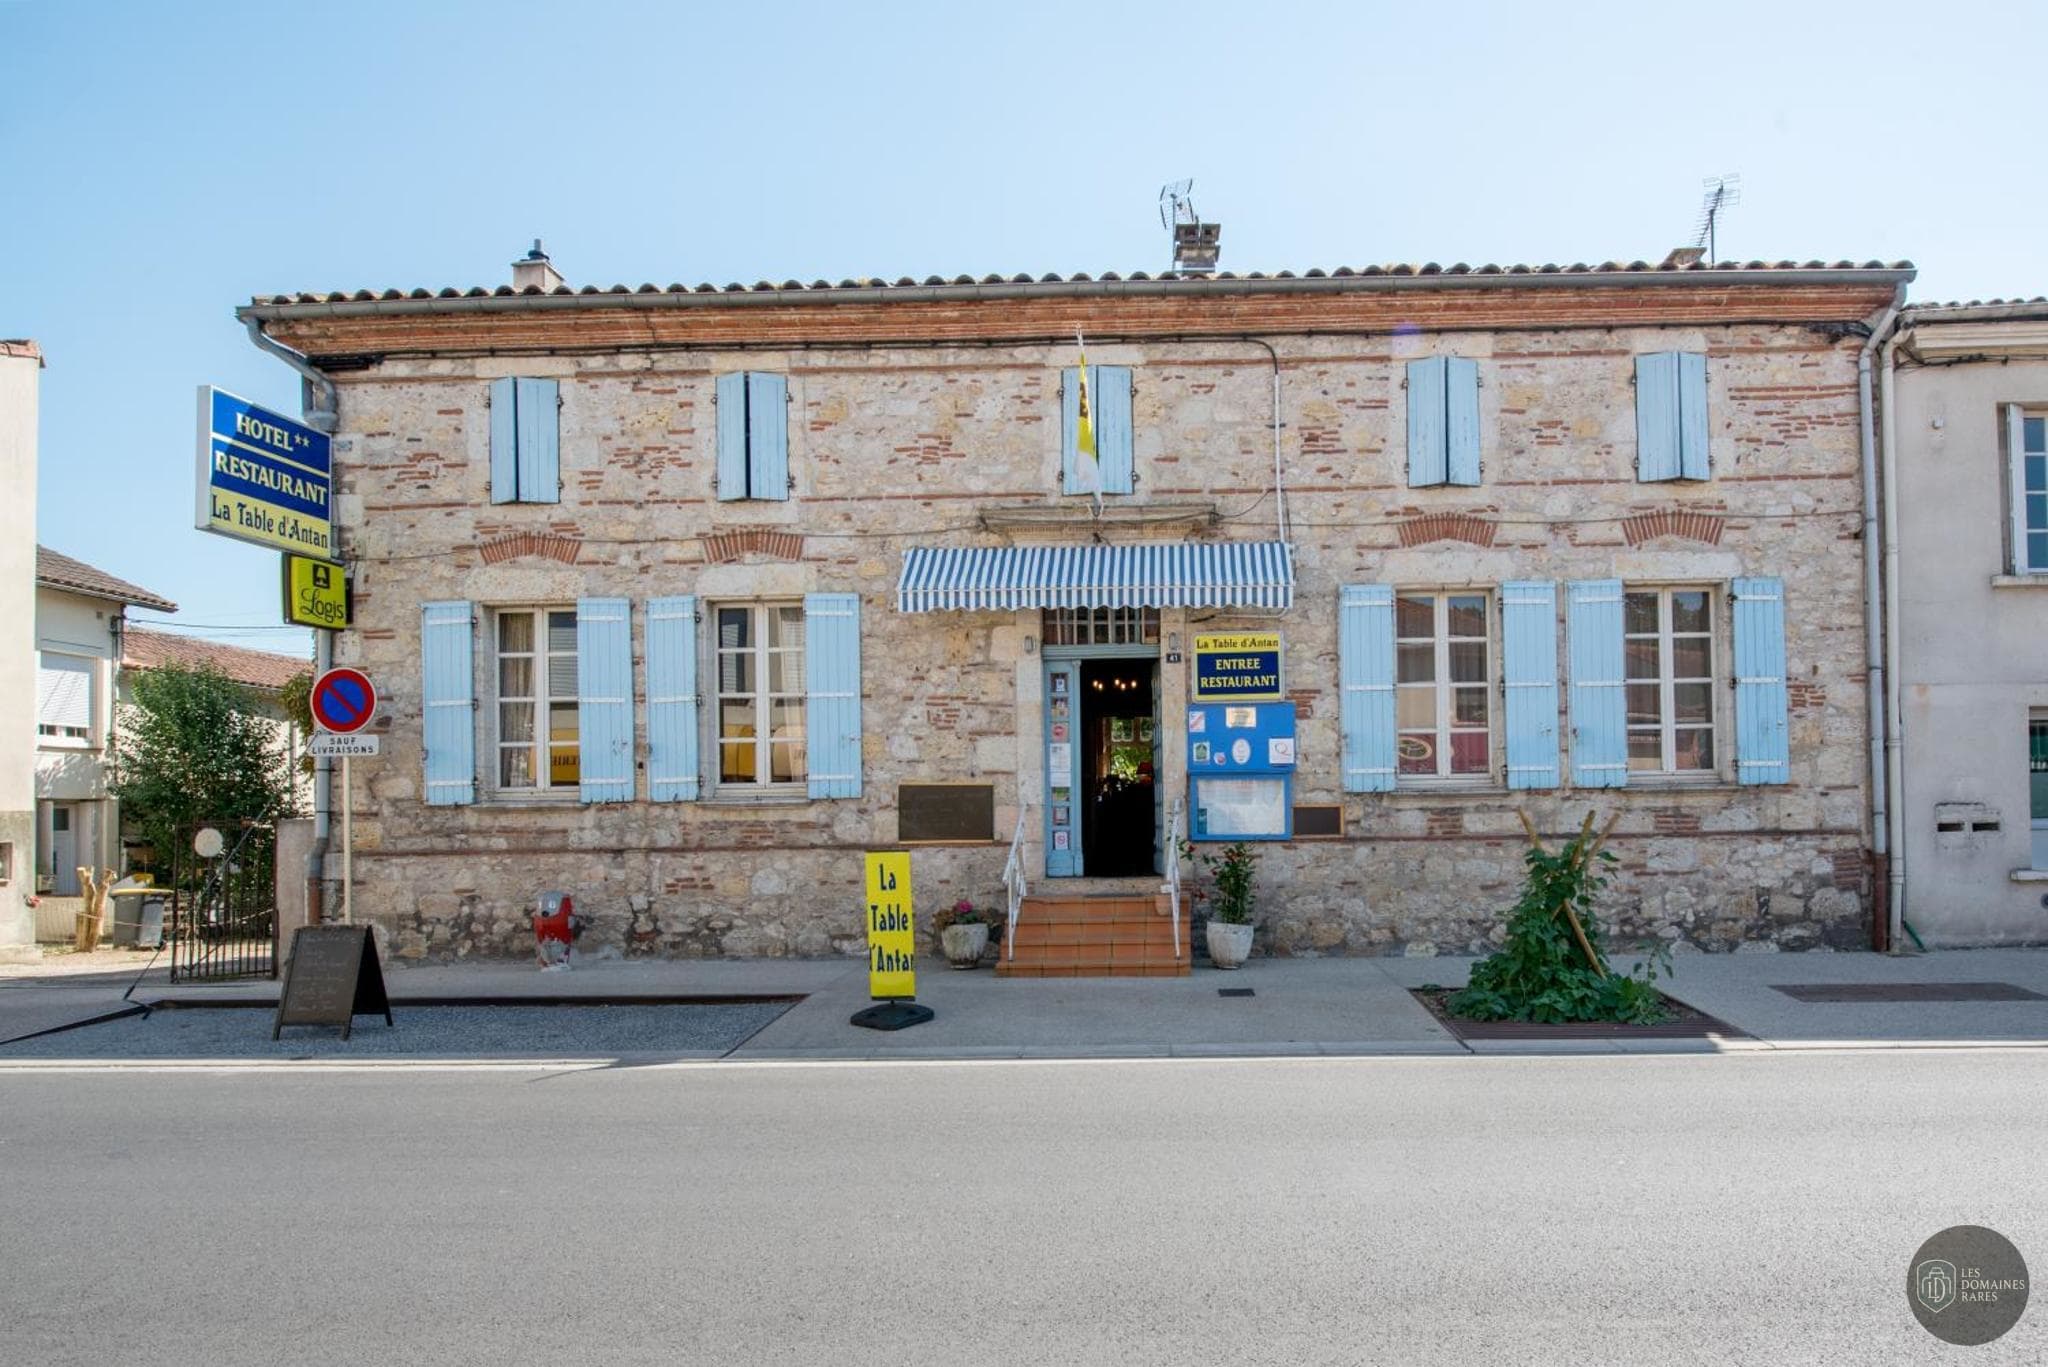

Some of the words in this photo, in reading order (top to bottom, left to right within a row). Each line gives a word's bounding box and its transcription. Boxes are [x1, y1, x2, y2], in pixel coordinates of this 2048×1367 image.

[236, 411, 294, 452] HOTEL
[214, 449, 328, 506] RESTAURANT
[211, 493, 231, 521] La
[237, 501, 274, 534] Table
[278, 516, 328, 549] d'Antan
[301, 586, 345, 624] Logis
[1196, 639, 1209, 650] La
[1213, 638, 1238, 649] Table
[1240, 637, 1279, 649] d'Antan
[1215, 657, 1261, 671] ENTREE
[1200, 675, 1277, 688] RESTAURANT
[312, 746, 374, 755] LIVRAISONS
[329, 736, 356, 745] SAUF
[879, 863, 896, 891] La
[870, 903, 908, 932] Table
